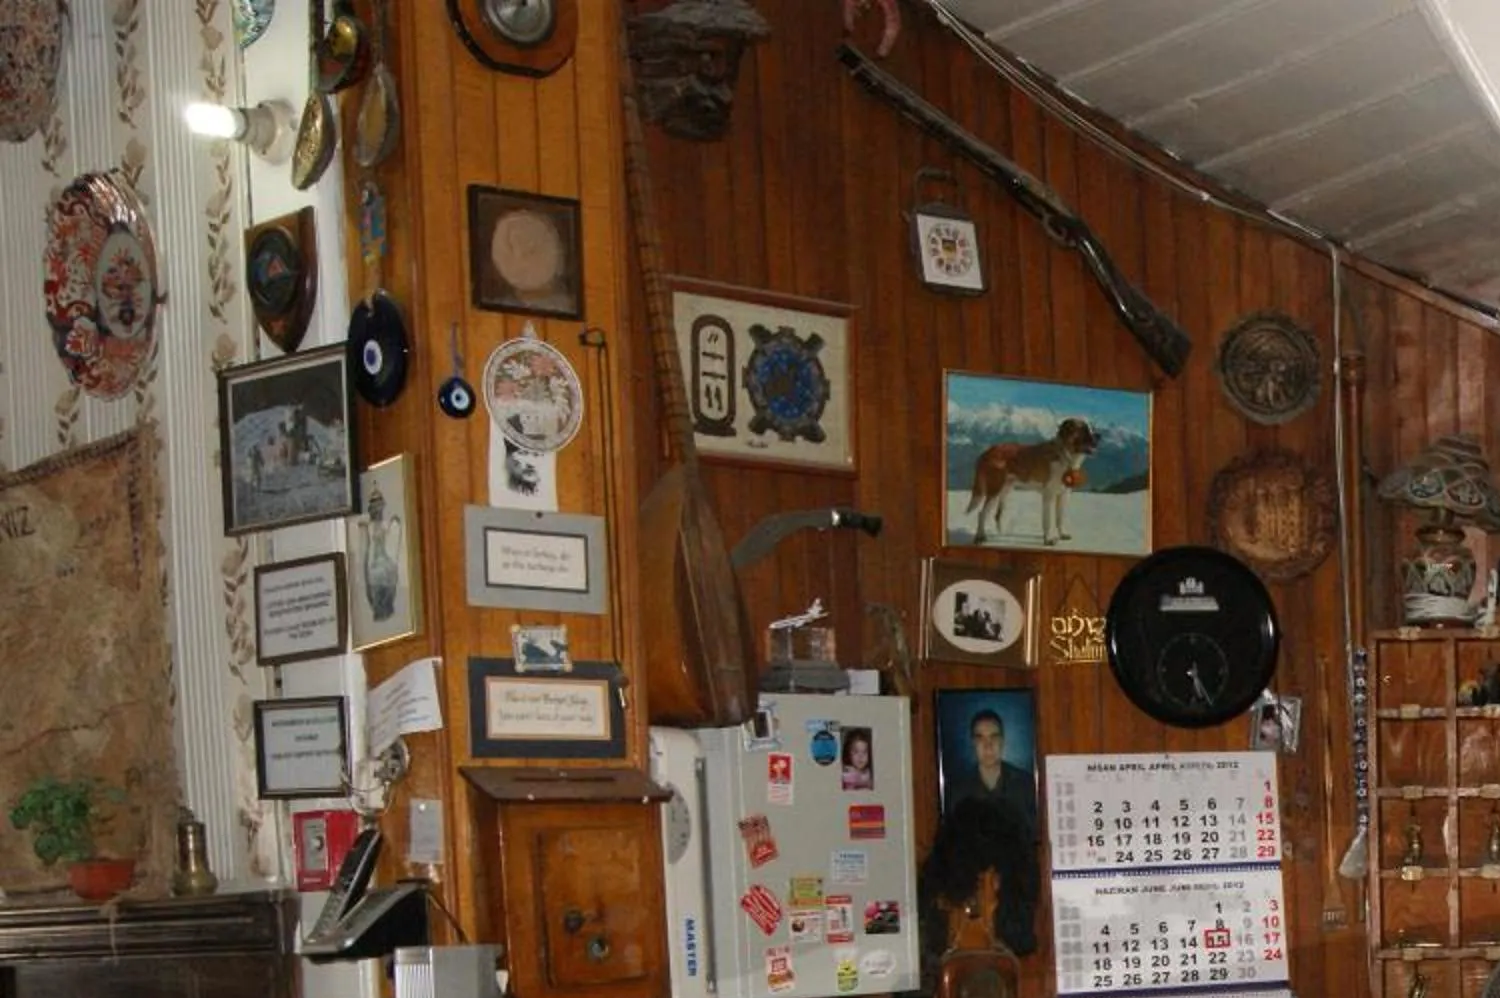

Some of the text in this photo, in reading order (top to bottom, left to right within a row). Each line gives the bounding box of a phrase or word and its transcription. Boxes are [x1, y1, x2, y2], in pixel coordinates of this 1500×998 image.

[1264, 780, 1270, 792] 1
[1094, 802, 1102, 813] 2
[1122, 800, 1131, 813] 3
[1151, 800, 1160, 811] 4
[1180, 799, 1188, 811] 5
[1208, 798, 1216, 810] 6
[1236, 797, 1245, 809] 7
[1265, 796, 1273, 808] 8
[1094, 818, 1104, 830] 9
[1114, 818, 1132, 829] 10
[1143, 816, 1159, 828] 11
[1172, 816, 1190, 827] 12
[1200, 815, 1217, 826] 13
[1256, 812, 1274, 824] 15
[1087, 835, 1104, 847] 16
[1115, 834, 1132, 846] 17
[1144, 833, 1162, 845] 18
[1173, 832, 1191, 844] 19
[1201, 831, 1219, 843] 20
[1258, 829, 1274, 841] 22
[1116, 851, 1134, 863] 24
[1144, 850, 1163, 862] 25
[1173, 848, 1192, 860] 26
[1202, 848, 1220, 860] 27
[1258, 846, 1276, 857] 29
[1216, 902, 1221, 913] 1
[1271, 900, 1279, 911] 3
[1101, 925, 1110, 935] 4
[1130, 923, 1139, 935] 5
[1159, 922, 1168, 934] 6
[1188, 920, 1196, 932] 7
[1215, 919, 1224, 929] 8
[1263, 916, 1280, 929] 10
[1093, 942, 1109, 953] 11
[1122, 940, 1139, 952] 12
[1150, 938, 1168, 950] 13
[1180, 936, 1198, 948] 14
[1209, 936, 1224, 946] 15
[1264, 932, 1281, 944] 17
[1094, 957, 1112, 970] 18
[1123, 956, 1141, 969] 19
[1152, 955, 1170, 967] 20
[1180, 954, 1196, 966] 21
[1208, 952, 1226, 964] 22
[1264, 948, 1282, 960] 24
[1094, 976, 1112, 988] 25
[1123, 974, 1142, 987] 26
[1152, 972, 1170, 984] 27
[1181, 970, 1200, 982] 28
[1210, 968, 1228, 980] 29
